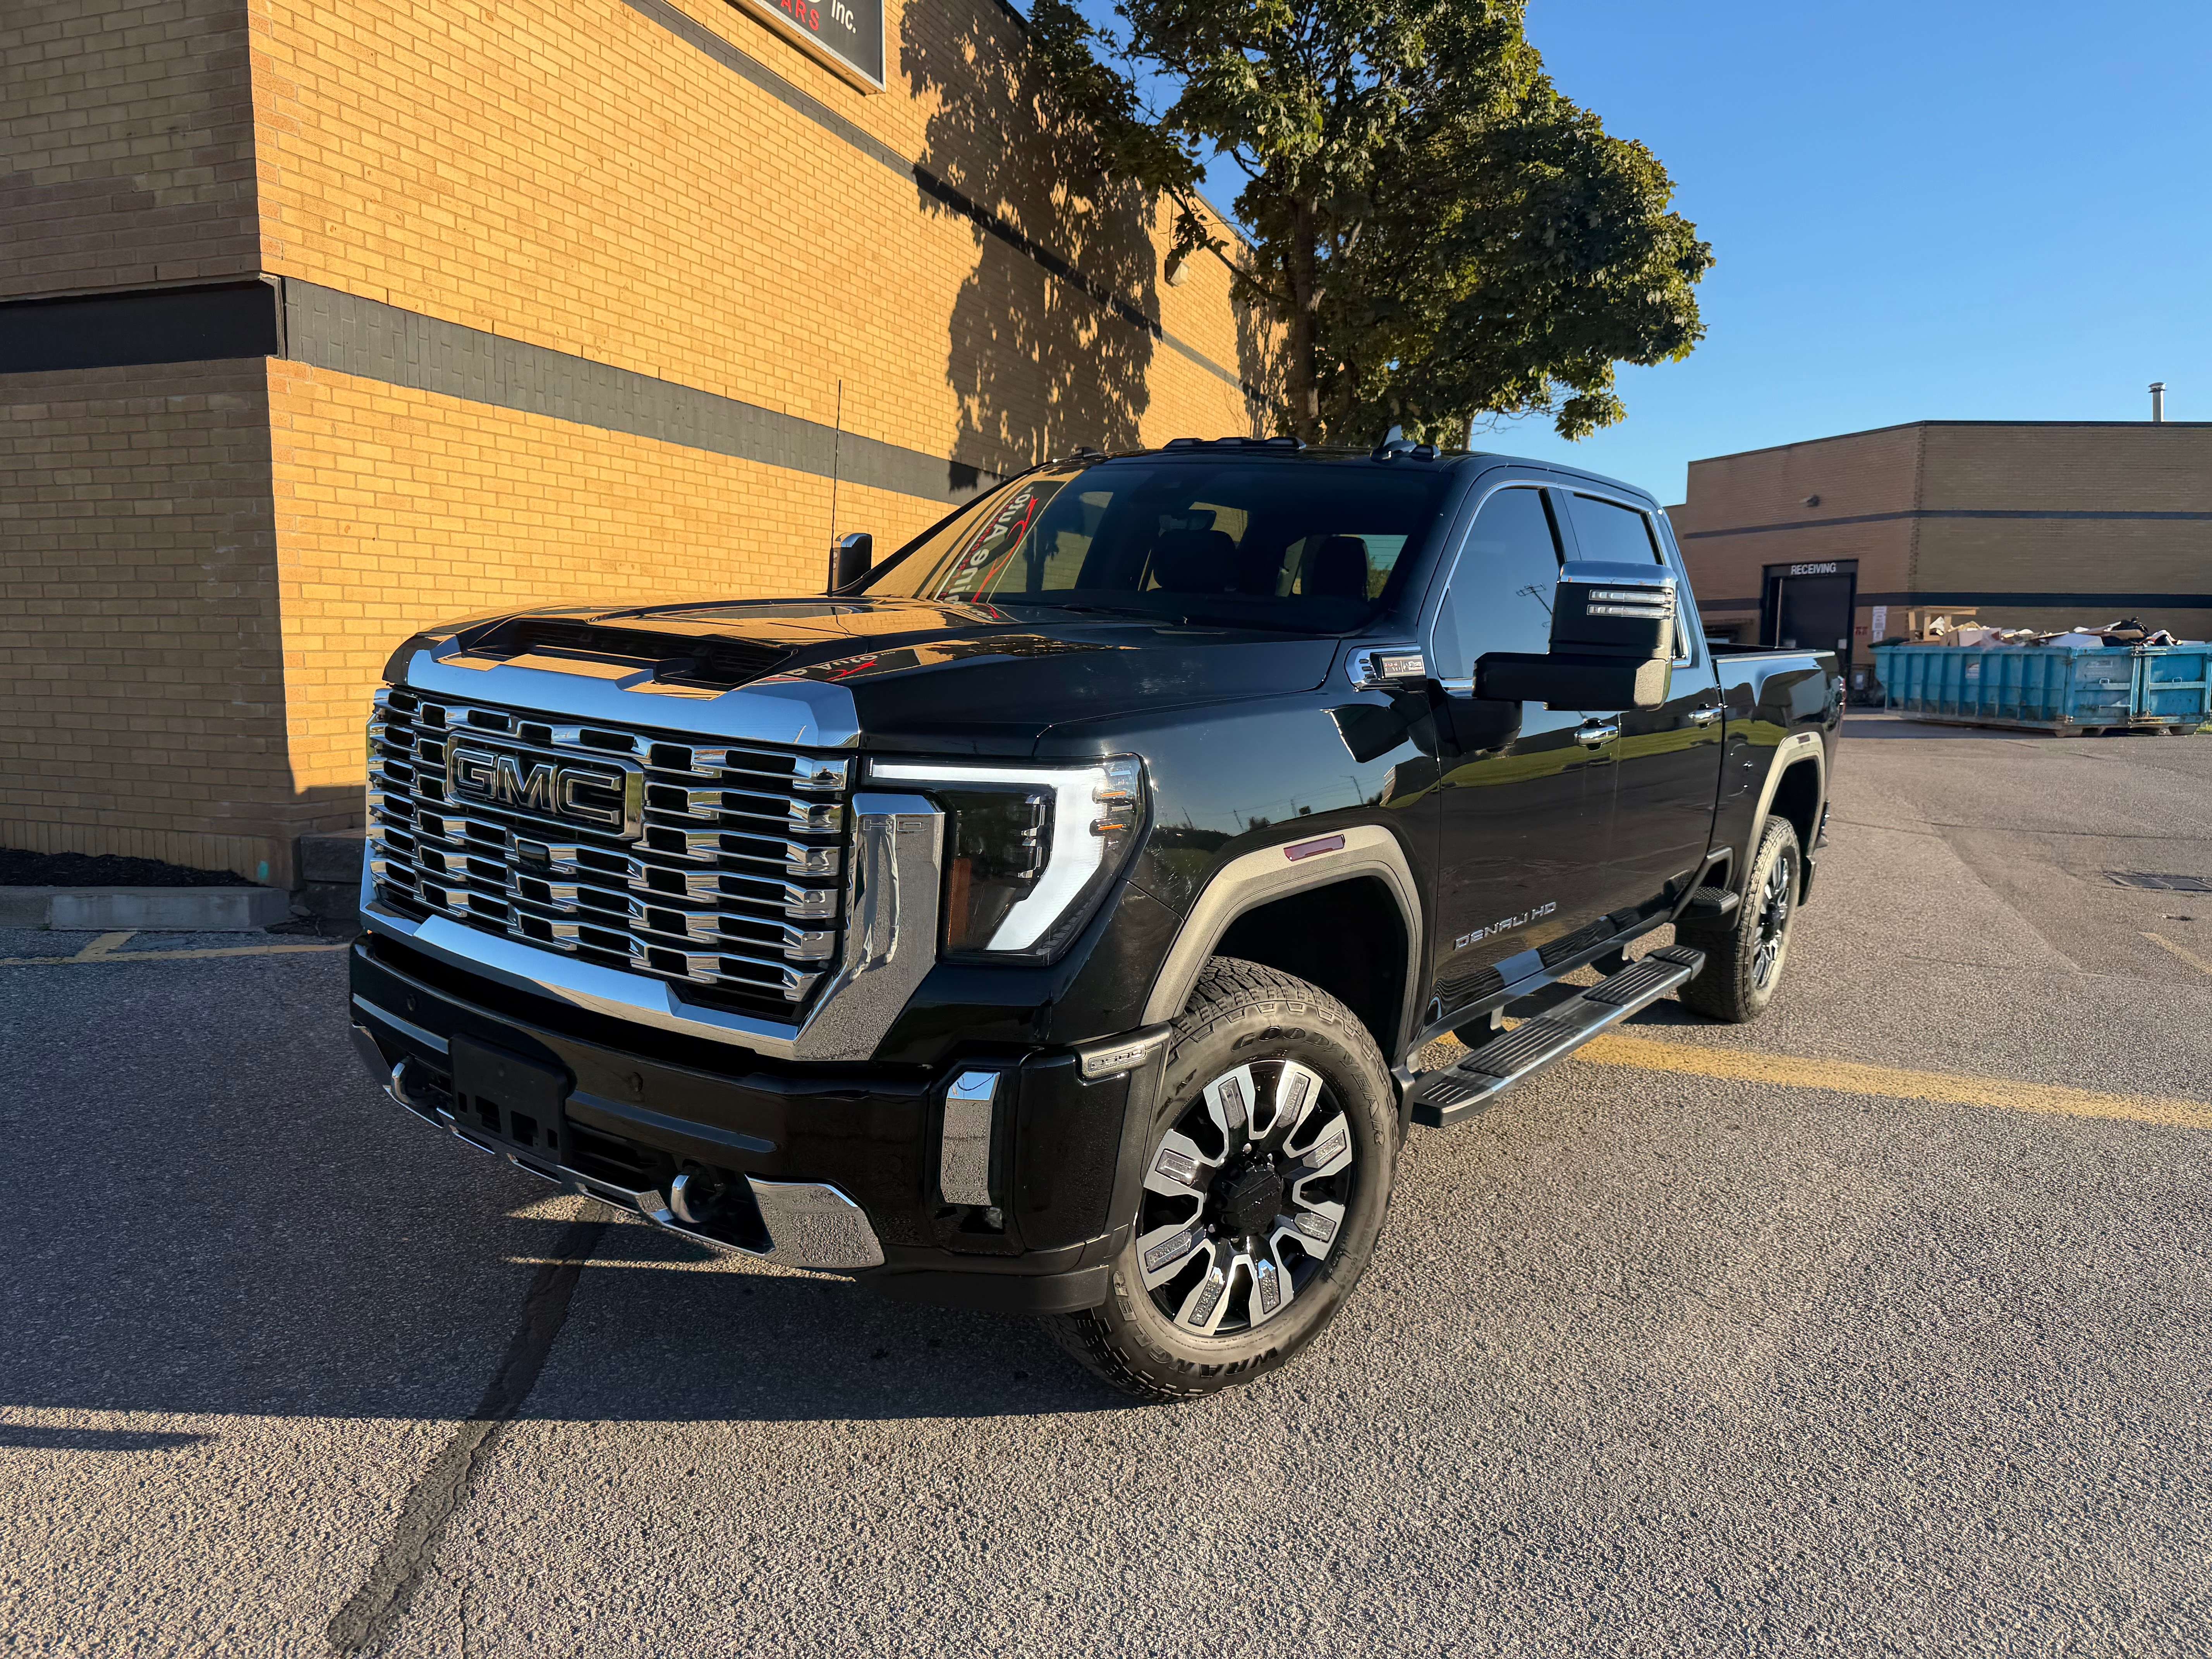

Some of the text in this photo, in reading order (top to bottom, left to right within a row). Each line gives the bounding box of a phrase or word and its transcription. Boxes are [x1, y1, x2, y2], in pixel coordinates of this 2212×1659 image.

[831, 0, 856, 34] Inc.
[1791, 562, 1837, 575] RECEIVING
[452, 748, 622, 825] GMC
[1454, 902, 1557, 951] DENALI HD
[1113, 1270, 1278, 1377] WRANGLER
